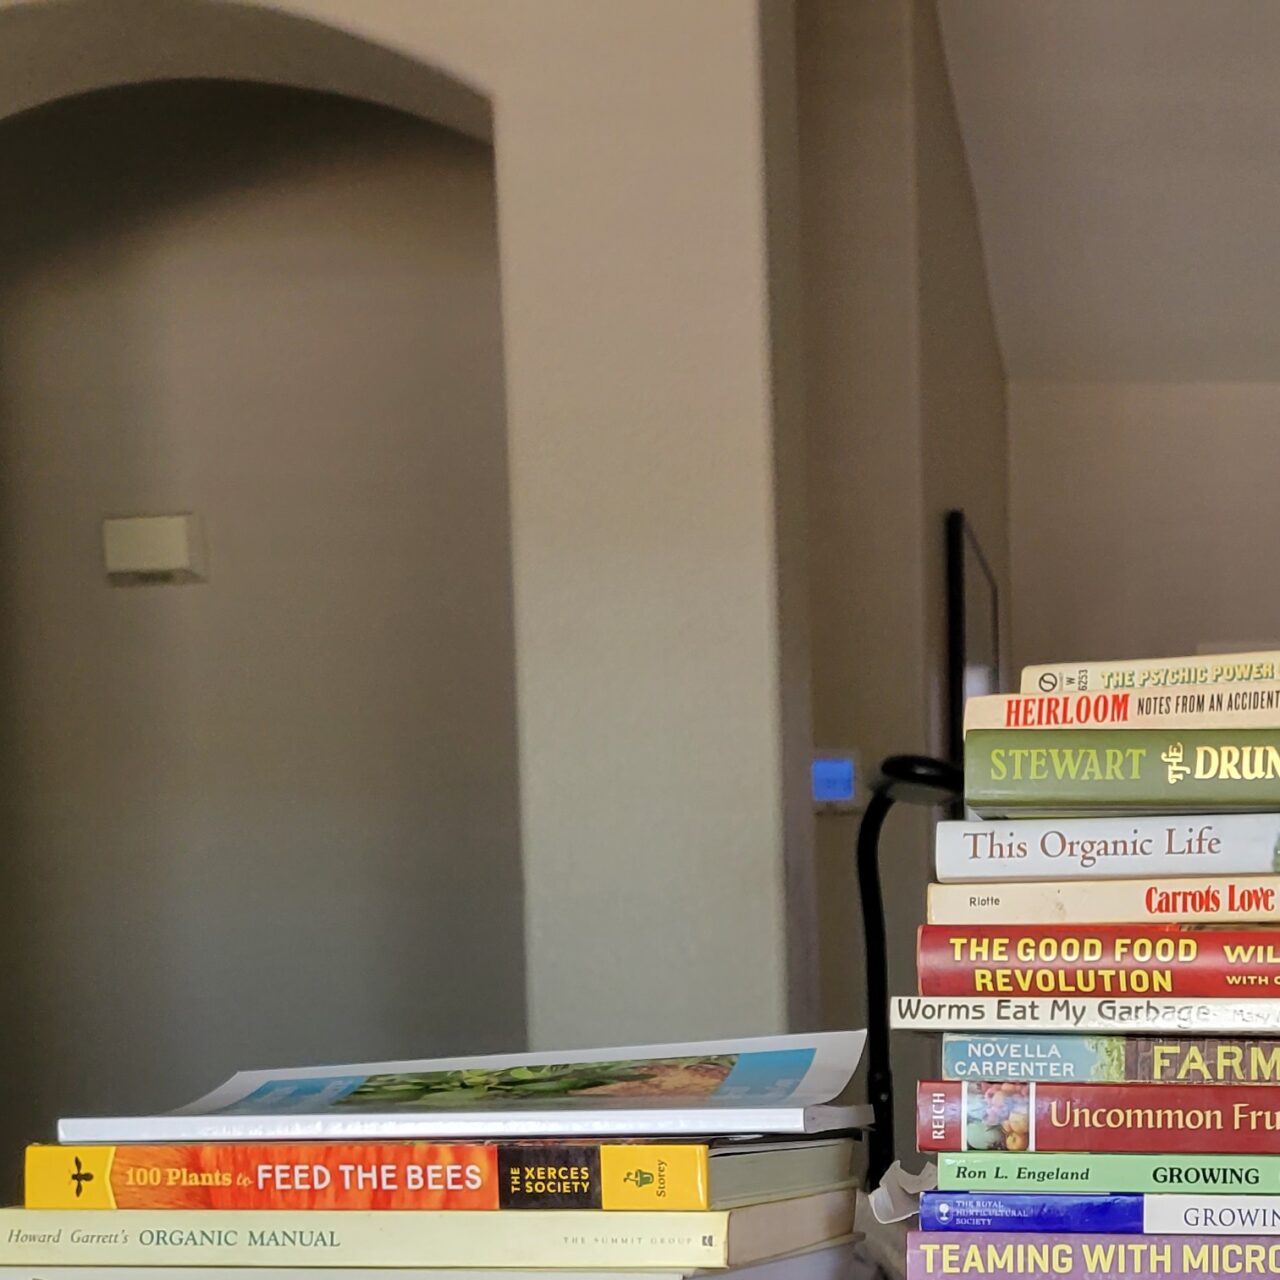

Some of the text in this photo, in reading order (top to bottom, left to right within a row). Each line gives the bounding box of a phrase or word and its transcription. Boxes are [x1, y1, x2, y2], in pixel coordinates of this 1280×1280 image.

[1100, 670, 1134, 688] THE
[1138, 665, 1208, 686] PSYCHIC
[1211, 662, 1274, 681] POWER
[1005, 693, 1130, 727] HEIRLOOM
[1137, 697, 1171, 716] NOTES
[1175, 695, 1205, 714] FROM
[1208, 694, 1224, 712] AN
[990, 748, 1146, 781] STEWART
[1161, 742, 1190, 784] THE
[963, 825, 1222, 867] This Organic Life
[969, 896, 1000, 907] Riotte
[1145, 886, 1220, 914] Carrots
[1228, 886, 1275, 912] Love
[967, 1044, 1061, 1057] NOVELLA
[954, 1062, 1075, 1077] CARPENTER
[932, 1093, 945, 1140] REICH
[125, 1168, 161, 1186] 100
[166, 1168, 232, 1186] Plants
[257, 1164, 331, 1190] FEED
[339, 1165, 397, 1189] THE
[406, 1165, 482, 1189] BEES
[525, 1167, 589, 1179] XERCES
[656, 1159, 667, 1198] Storey
[1152, 1167, 1260, 1184] GROWING
[525, 1181, 590, 1194] SOCIETY
